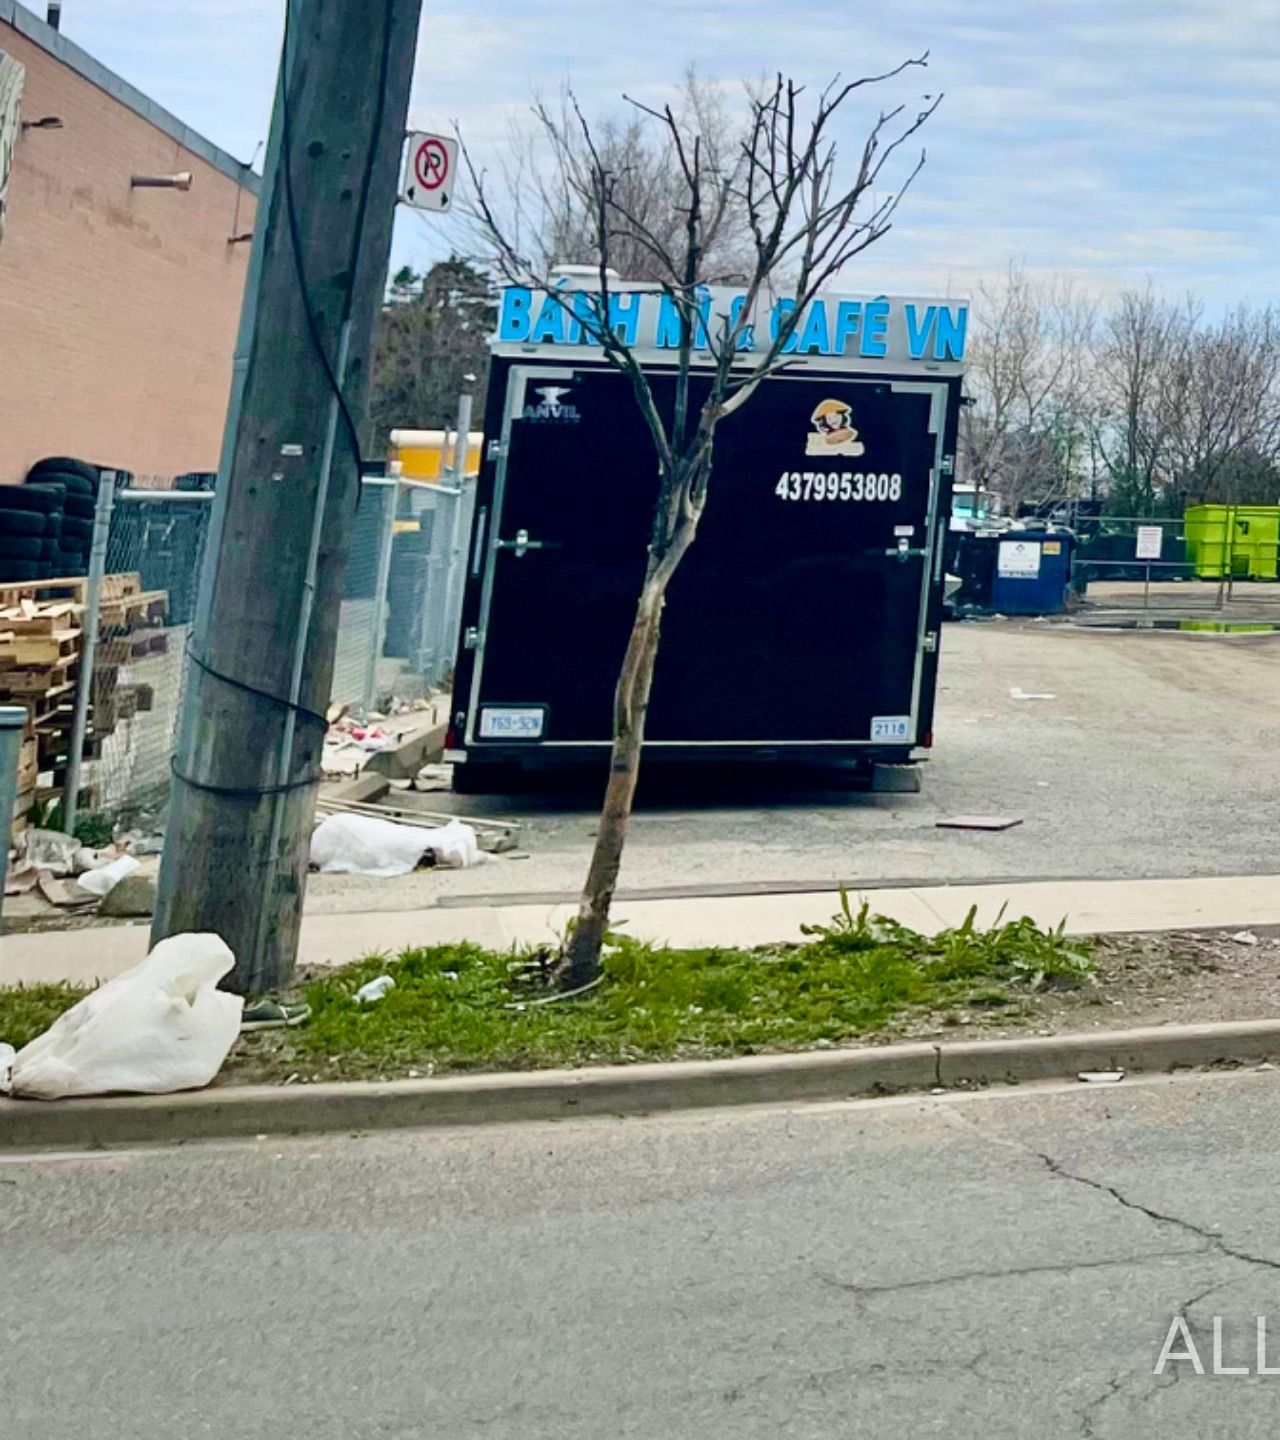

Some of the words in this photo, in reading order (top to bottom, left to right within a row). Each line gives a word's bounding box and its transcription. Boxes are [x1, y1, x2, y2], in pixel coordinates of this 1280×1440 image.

[770, 295, 891, 358] CAFÉ
[905, 304, 968, 360] VN
[523, 404, 581, 419] ANVIL
[775, 471, 902, 501] 4379953808
